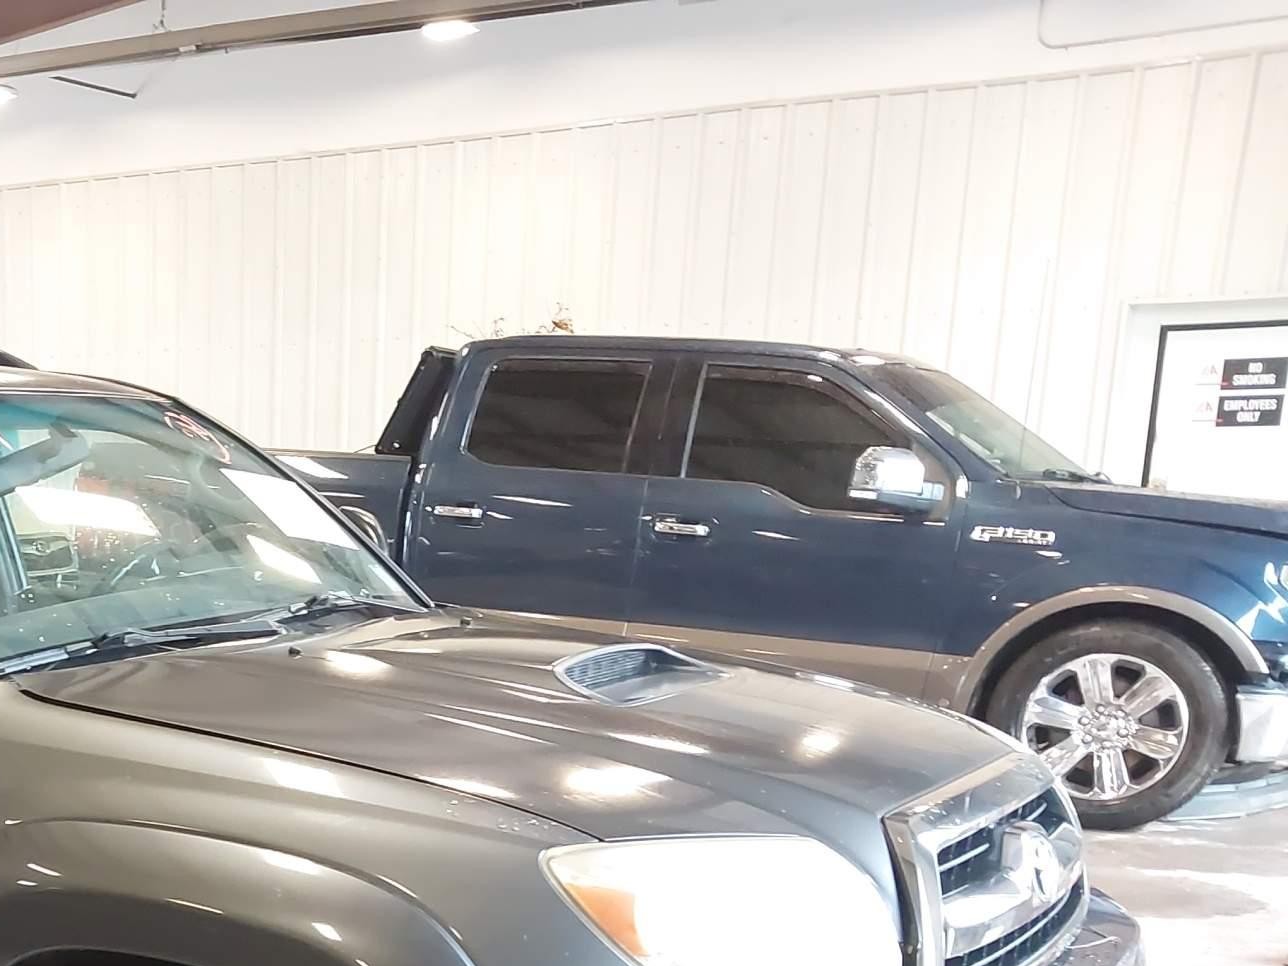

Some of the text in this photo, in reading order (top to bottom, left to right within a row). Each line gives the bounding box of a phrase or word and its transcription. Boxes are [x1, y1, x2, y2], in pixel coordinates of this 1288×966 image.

[1248, 362, 1263, 373] NO
[1233, 374, 1276, 386] SMOKING
[1223, 399, 1278, 411] EMPLOYEES
[1236, 411, 1261, 422] ONLY
